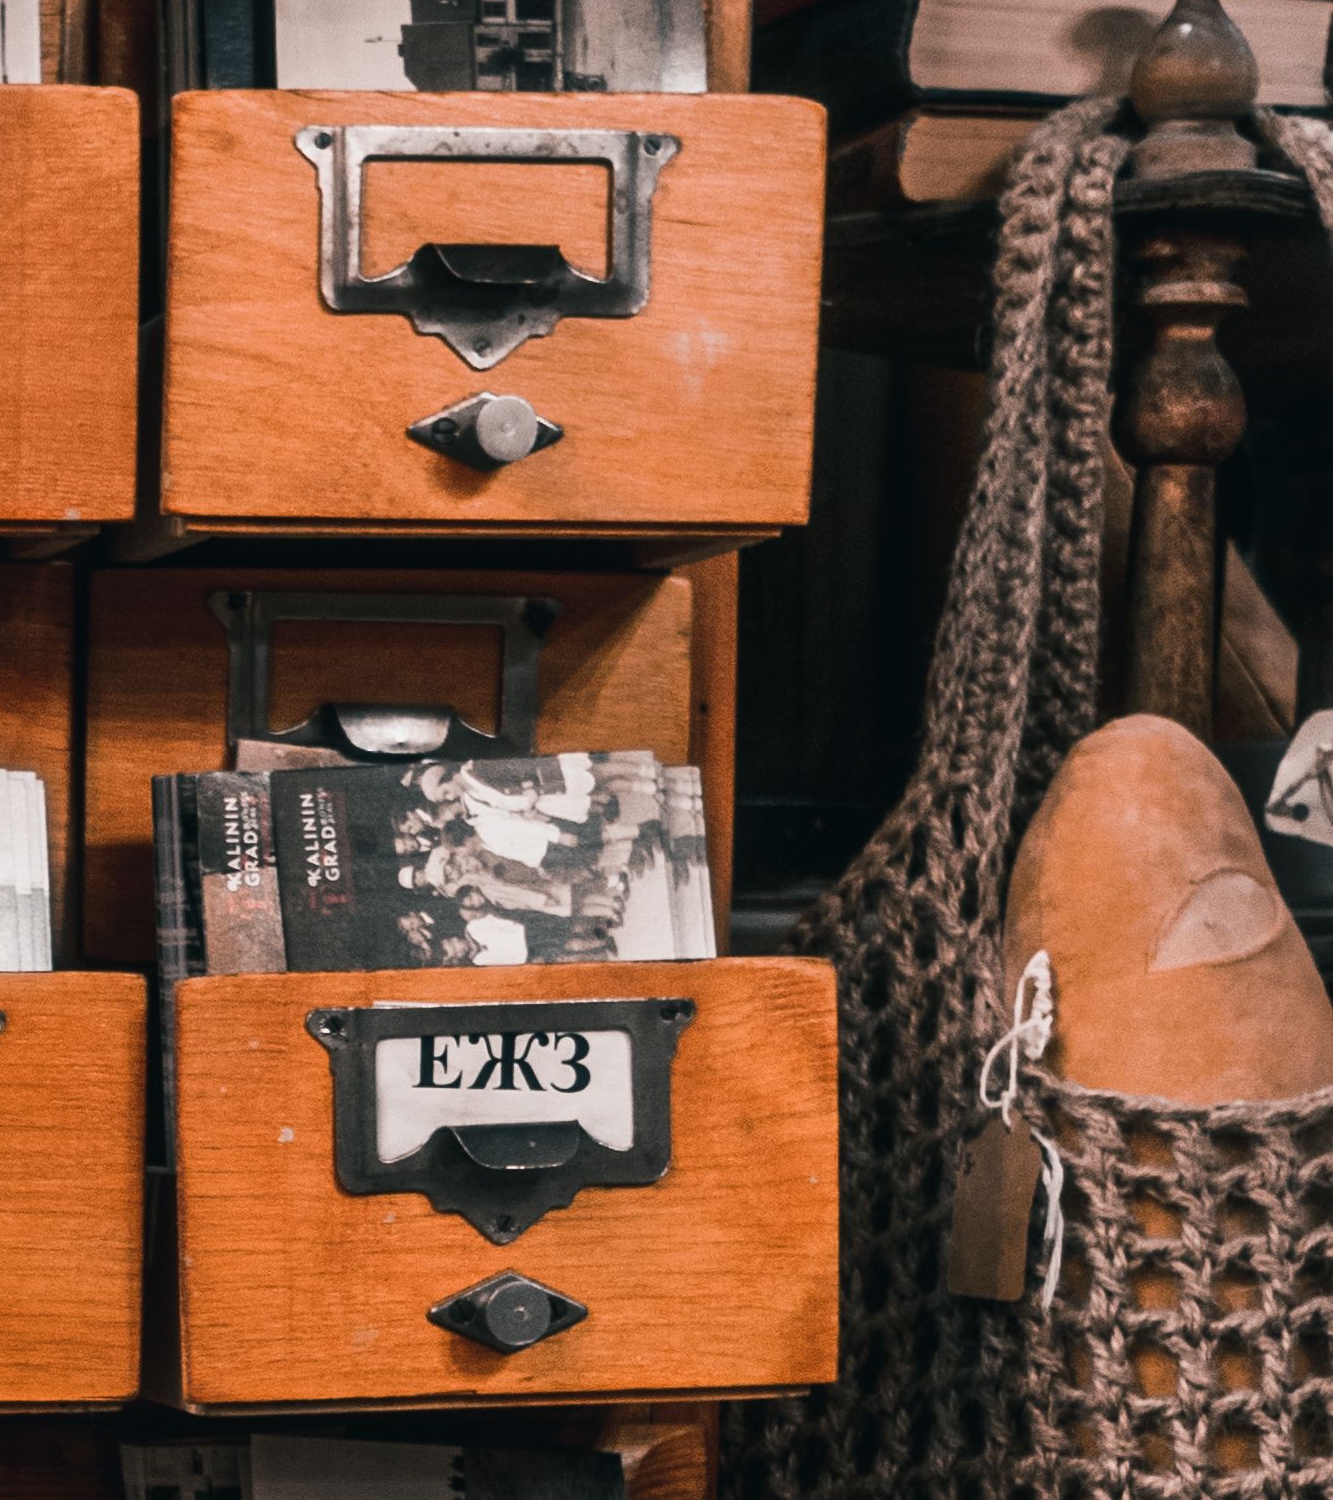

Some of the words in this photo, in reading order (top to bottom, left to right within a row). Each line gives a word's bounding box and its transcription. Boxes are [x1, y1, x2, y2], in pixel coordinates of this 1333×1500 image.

[224, 797, 242, 891] KALININ
[243, 831, 261, 887] GRAD
[300, 793, 322, 887] KALININ
[321, 826, 340, 882] GRAD
